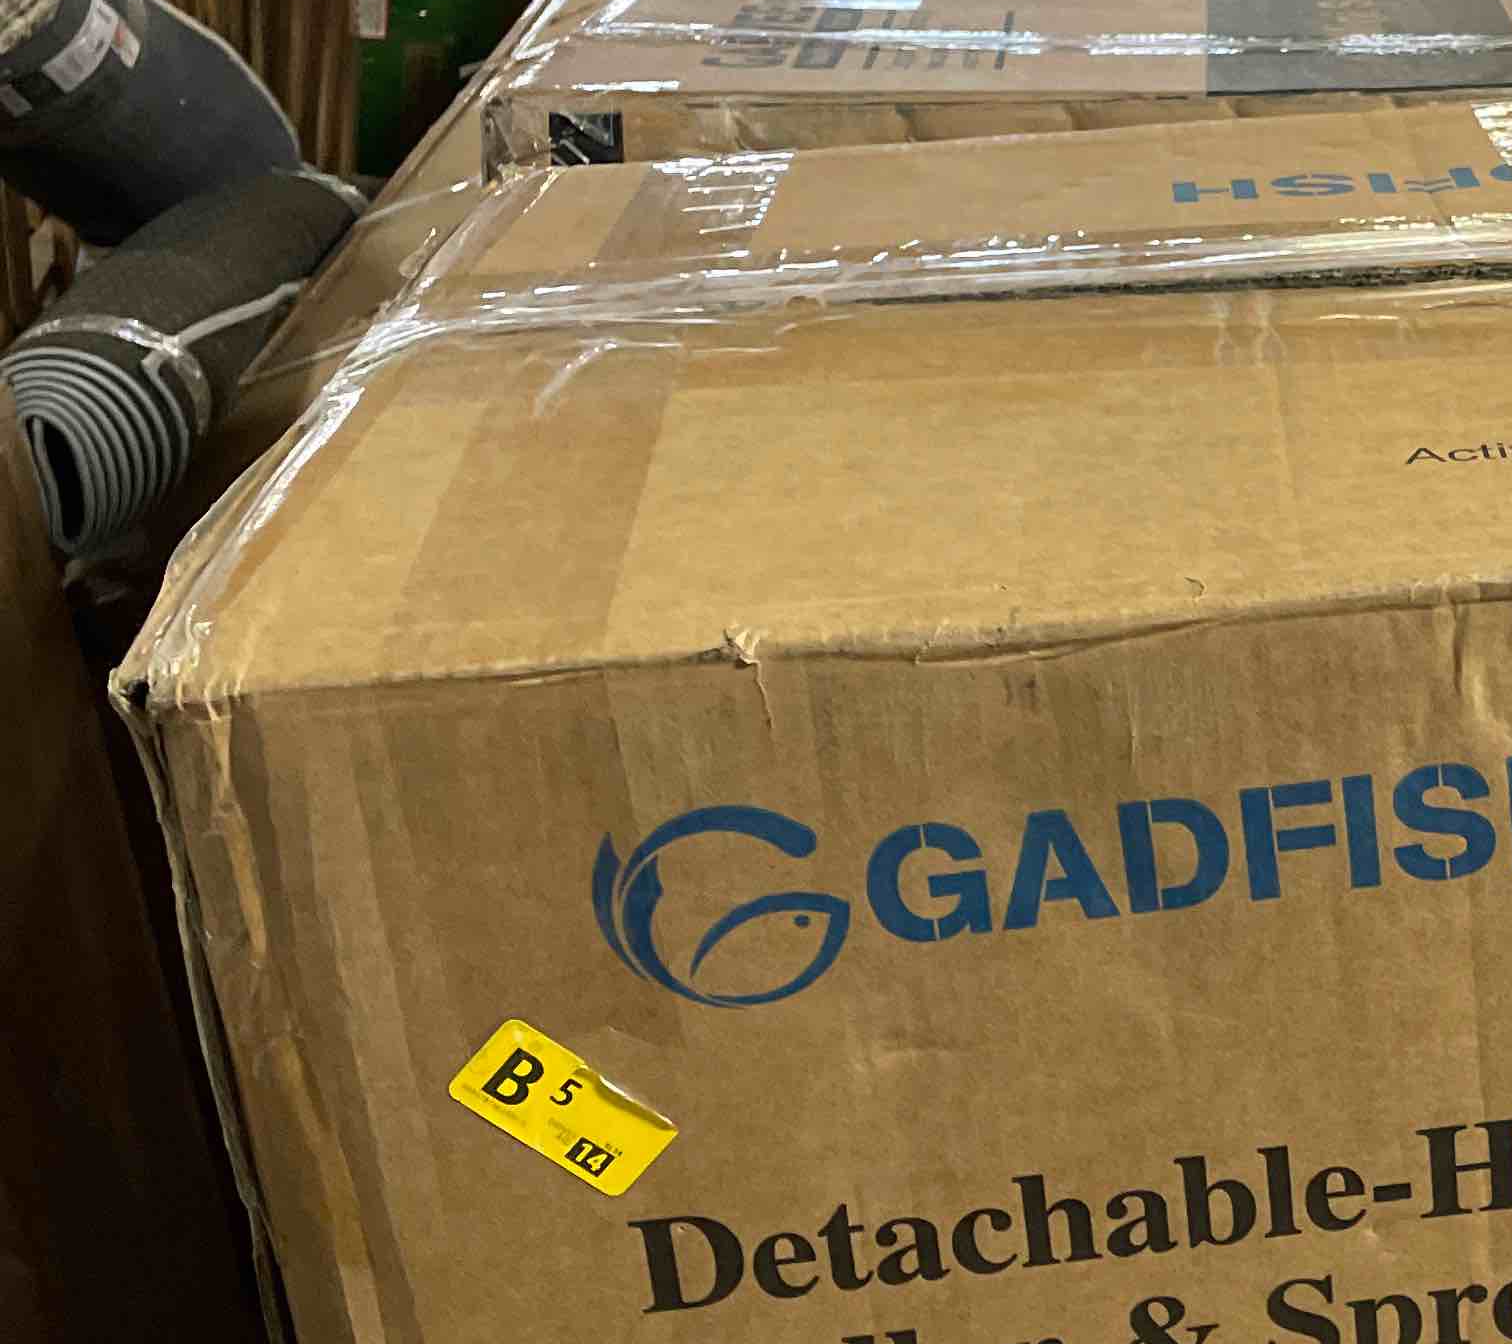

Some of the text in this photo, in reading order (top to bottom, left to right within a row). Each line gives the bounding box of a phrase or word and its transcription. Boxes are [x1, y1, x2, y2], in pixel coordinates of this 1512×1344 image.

[481, 1047, 584, 1107] B 5
[573, 1142, 609, 1173] 14
